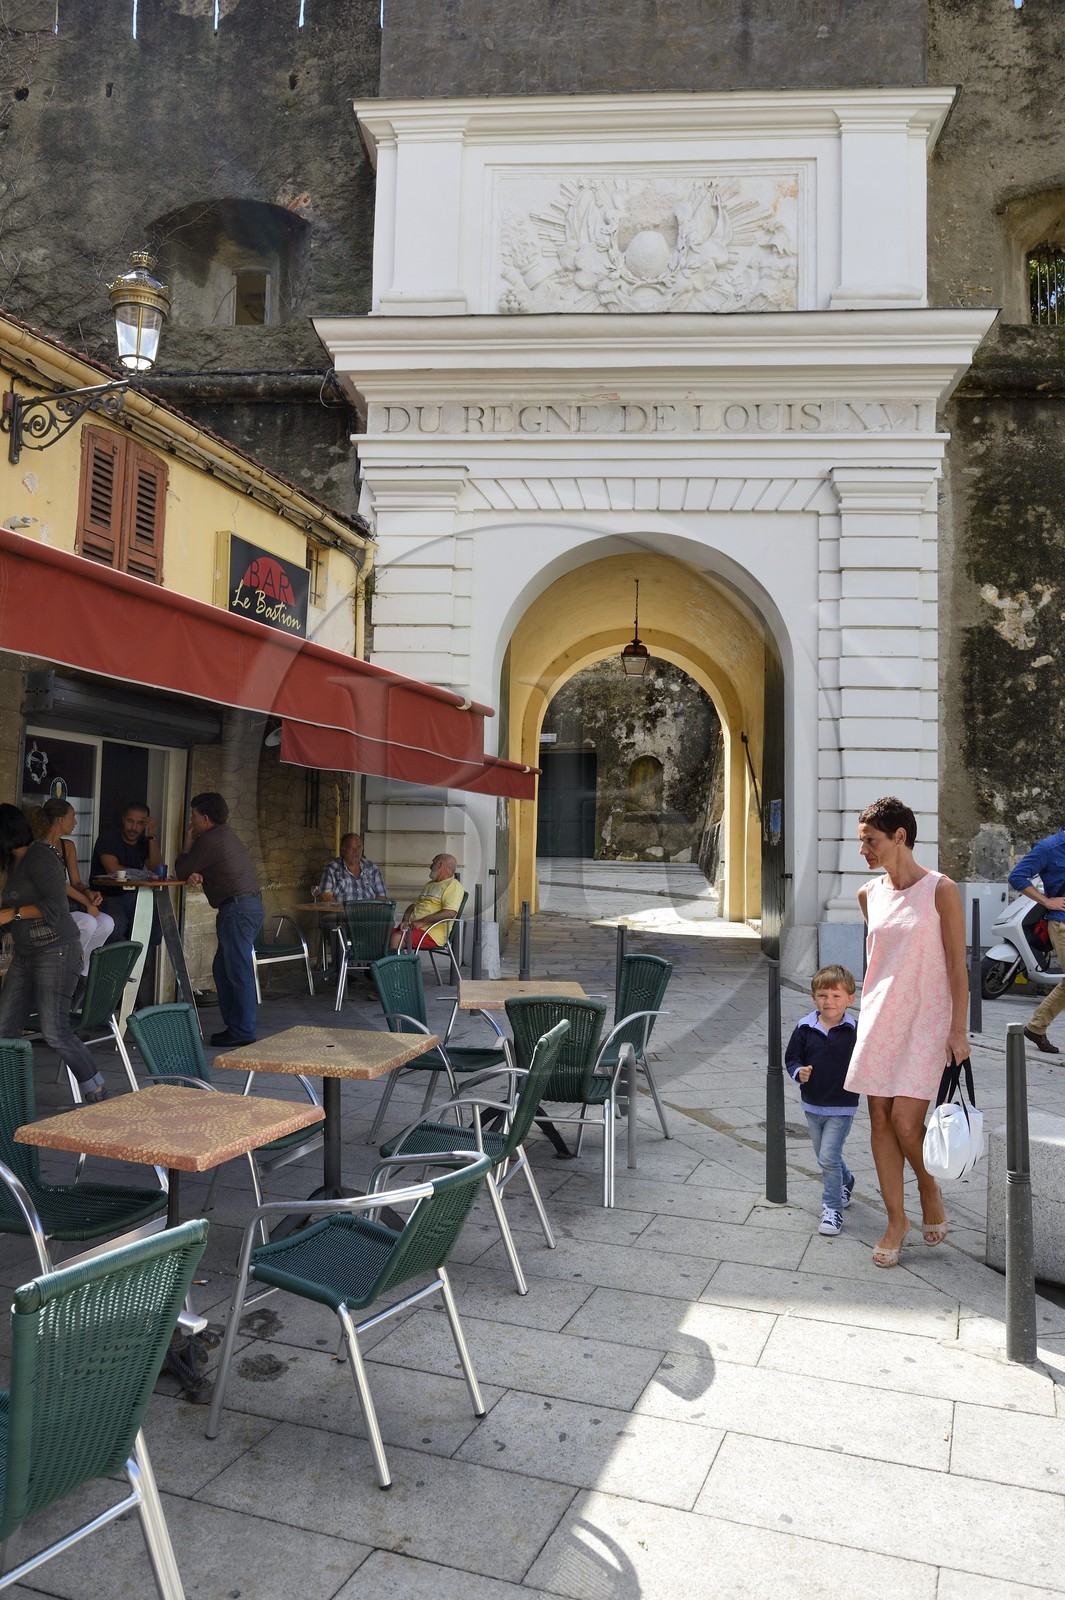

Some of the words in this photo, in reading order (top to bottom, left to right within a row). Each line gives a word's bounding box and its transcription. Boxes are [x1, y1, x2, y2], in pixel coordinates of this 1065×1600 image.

[382, 405, 444, 433] DU
[460, 405, 600, 433] REGNE
[618, 404, 677, 432] DE
[692, 403, 823, 432] LOUIS
[249, 560, 290, 604] BAR
[232, 580, 251, 609] Le
[255, 590, 301, 630] Bastion
